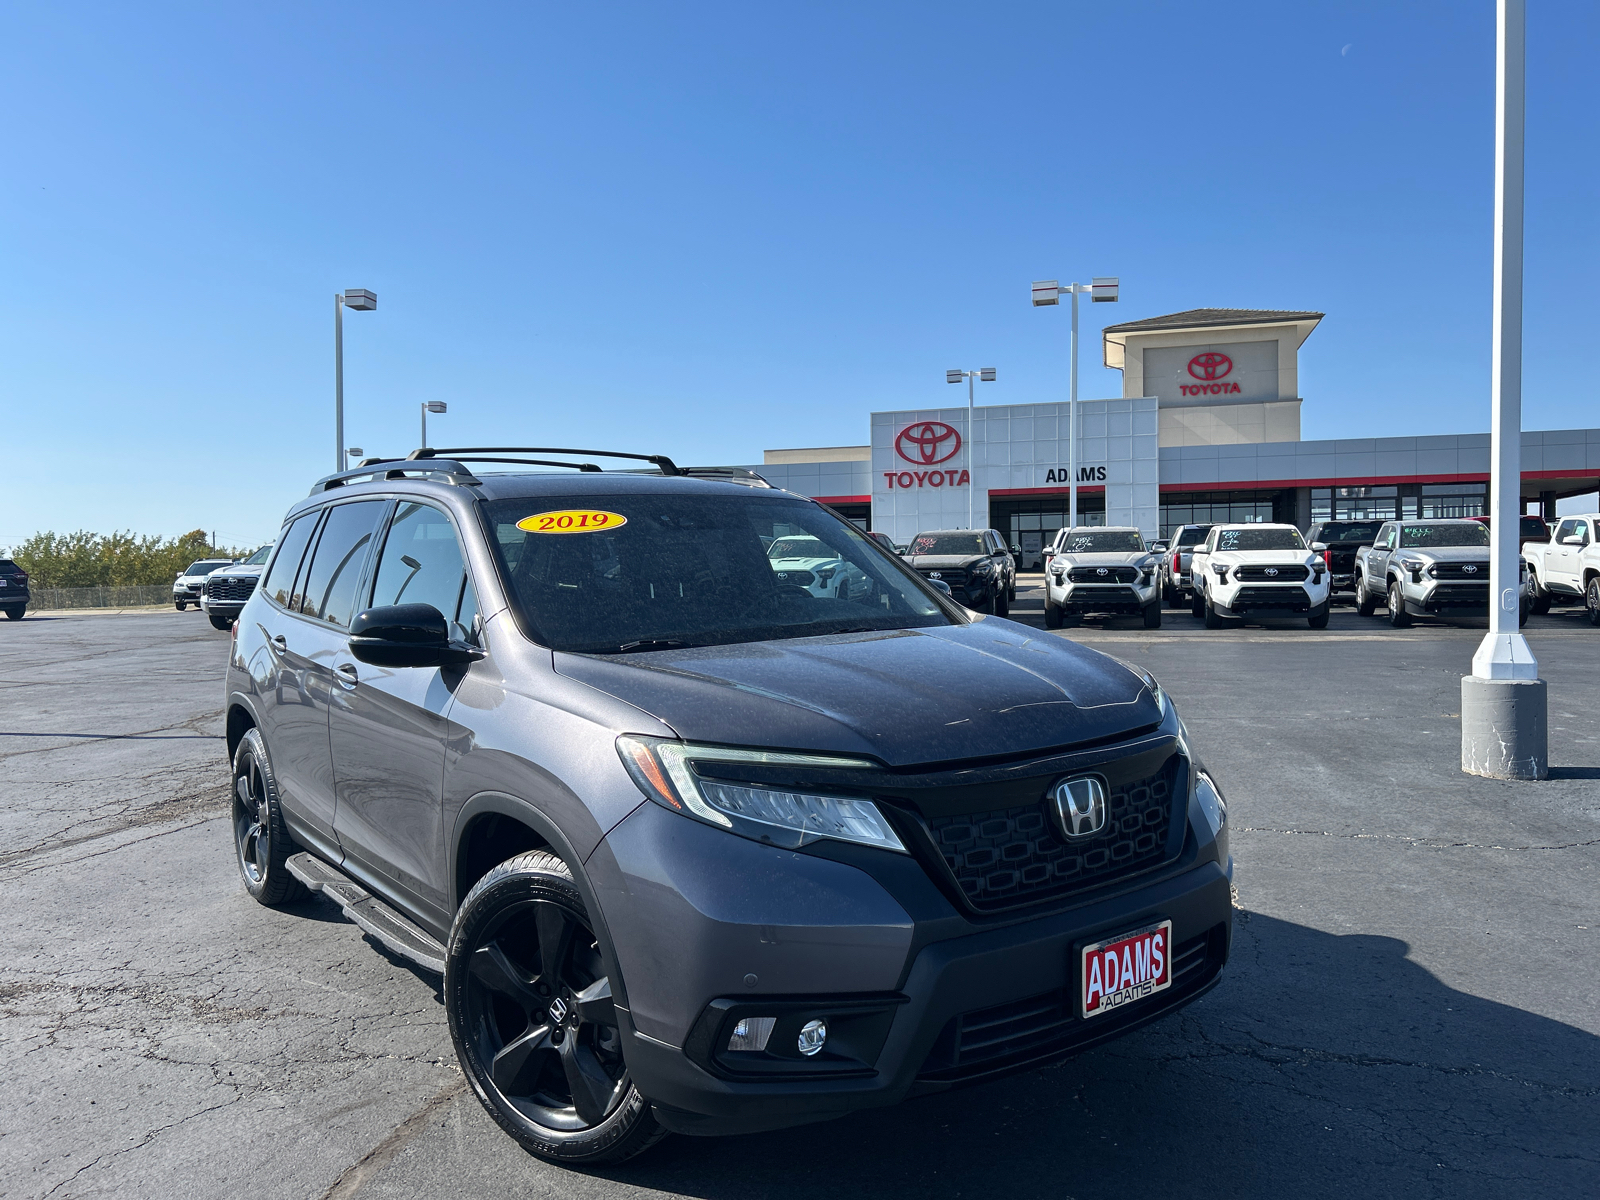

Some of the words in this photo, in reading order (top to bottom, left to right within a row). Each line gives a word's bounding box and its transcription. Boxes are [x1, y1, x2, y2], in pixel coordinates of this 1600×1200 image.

[1179, 382, 1242, 397] TOYOTA
[883, 469, 970, 489] TOYOTA
[538, 513, 609, 531] 2019
[1086, 933, 1164, 1004] ADAMS
[1104, 981, 1152, 1010] ADAMS
